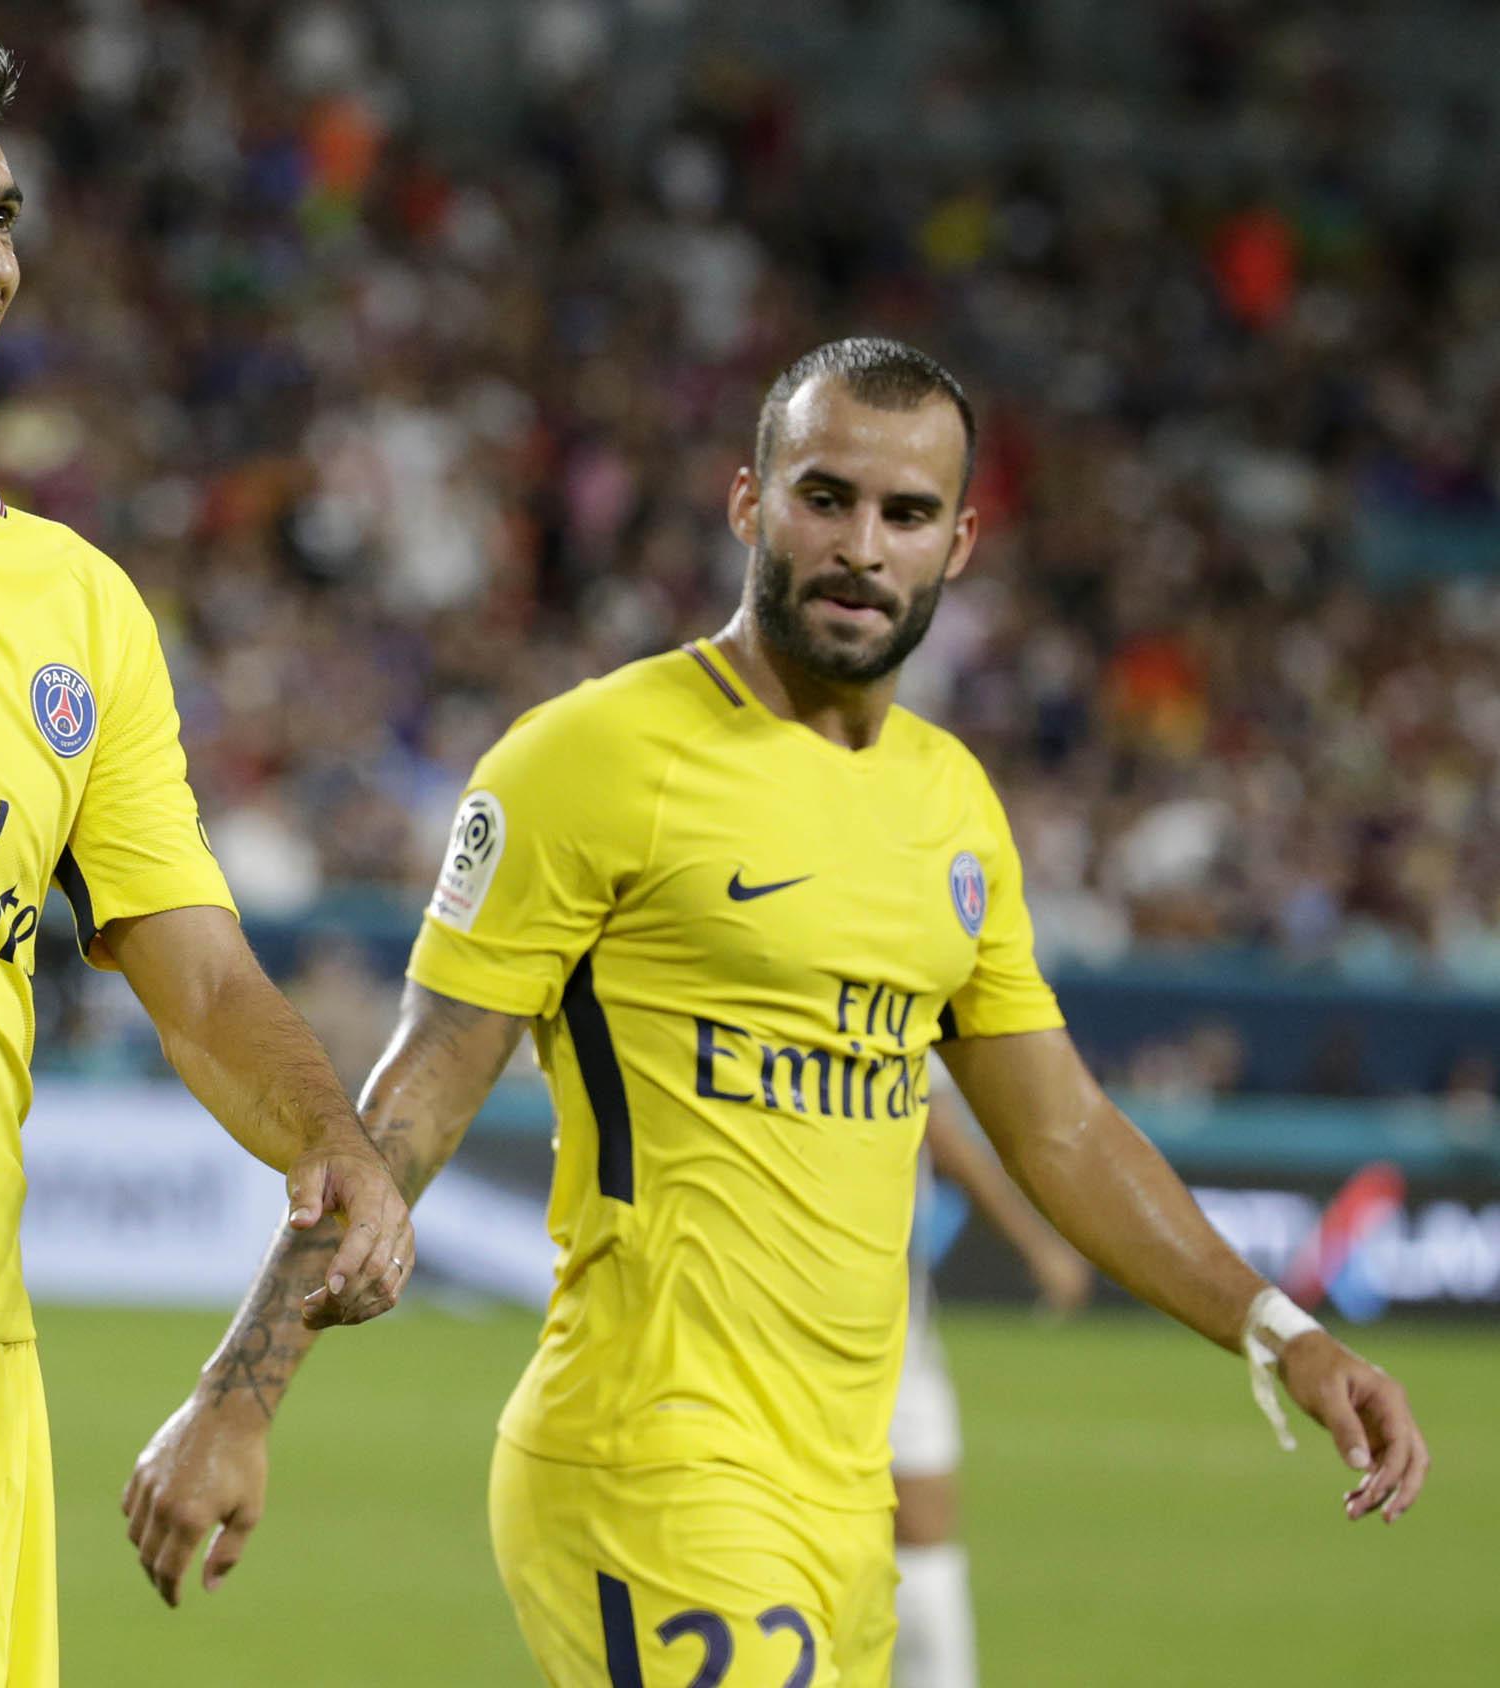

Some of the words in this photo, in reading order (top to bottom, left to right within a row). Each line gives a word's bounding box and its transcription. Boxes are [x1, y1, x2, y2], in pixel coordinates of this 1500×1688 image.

[42, 671, 86, 698] PARIS
[836, 979, 918, 1048] Fly
[692, 1016, 930, 1120] Emira
[655, 1604, 816, 1688] 22
